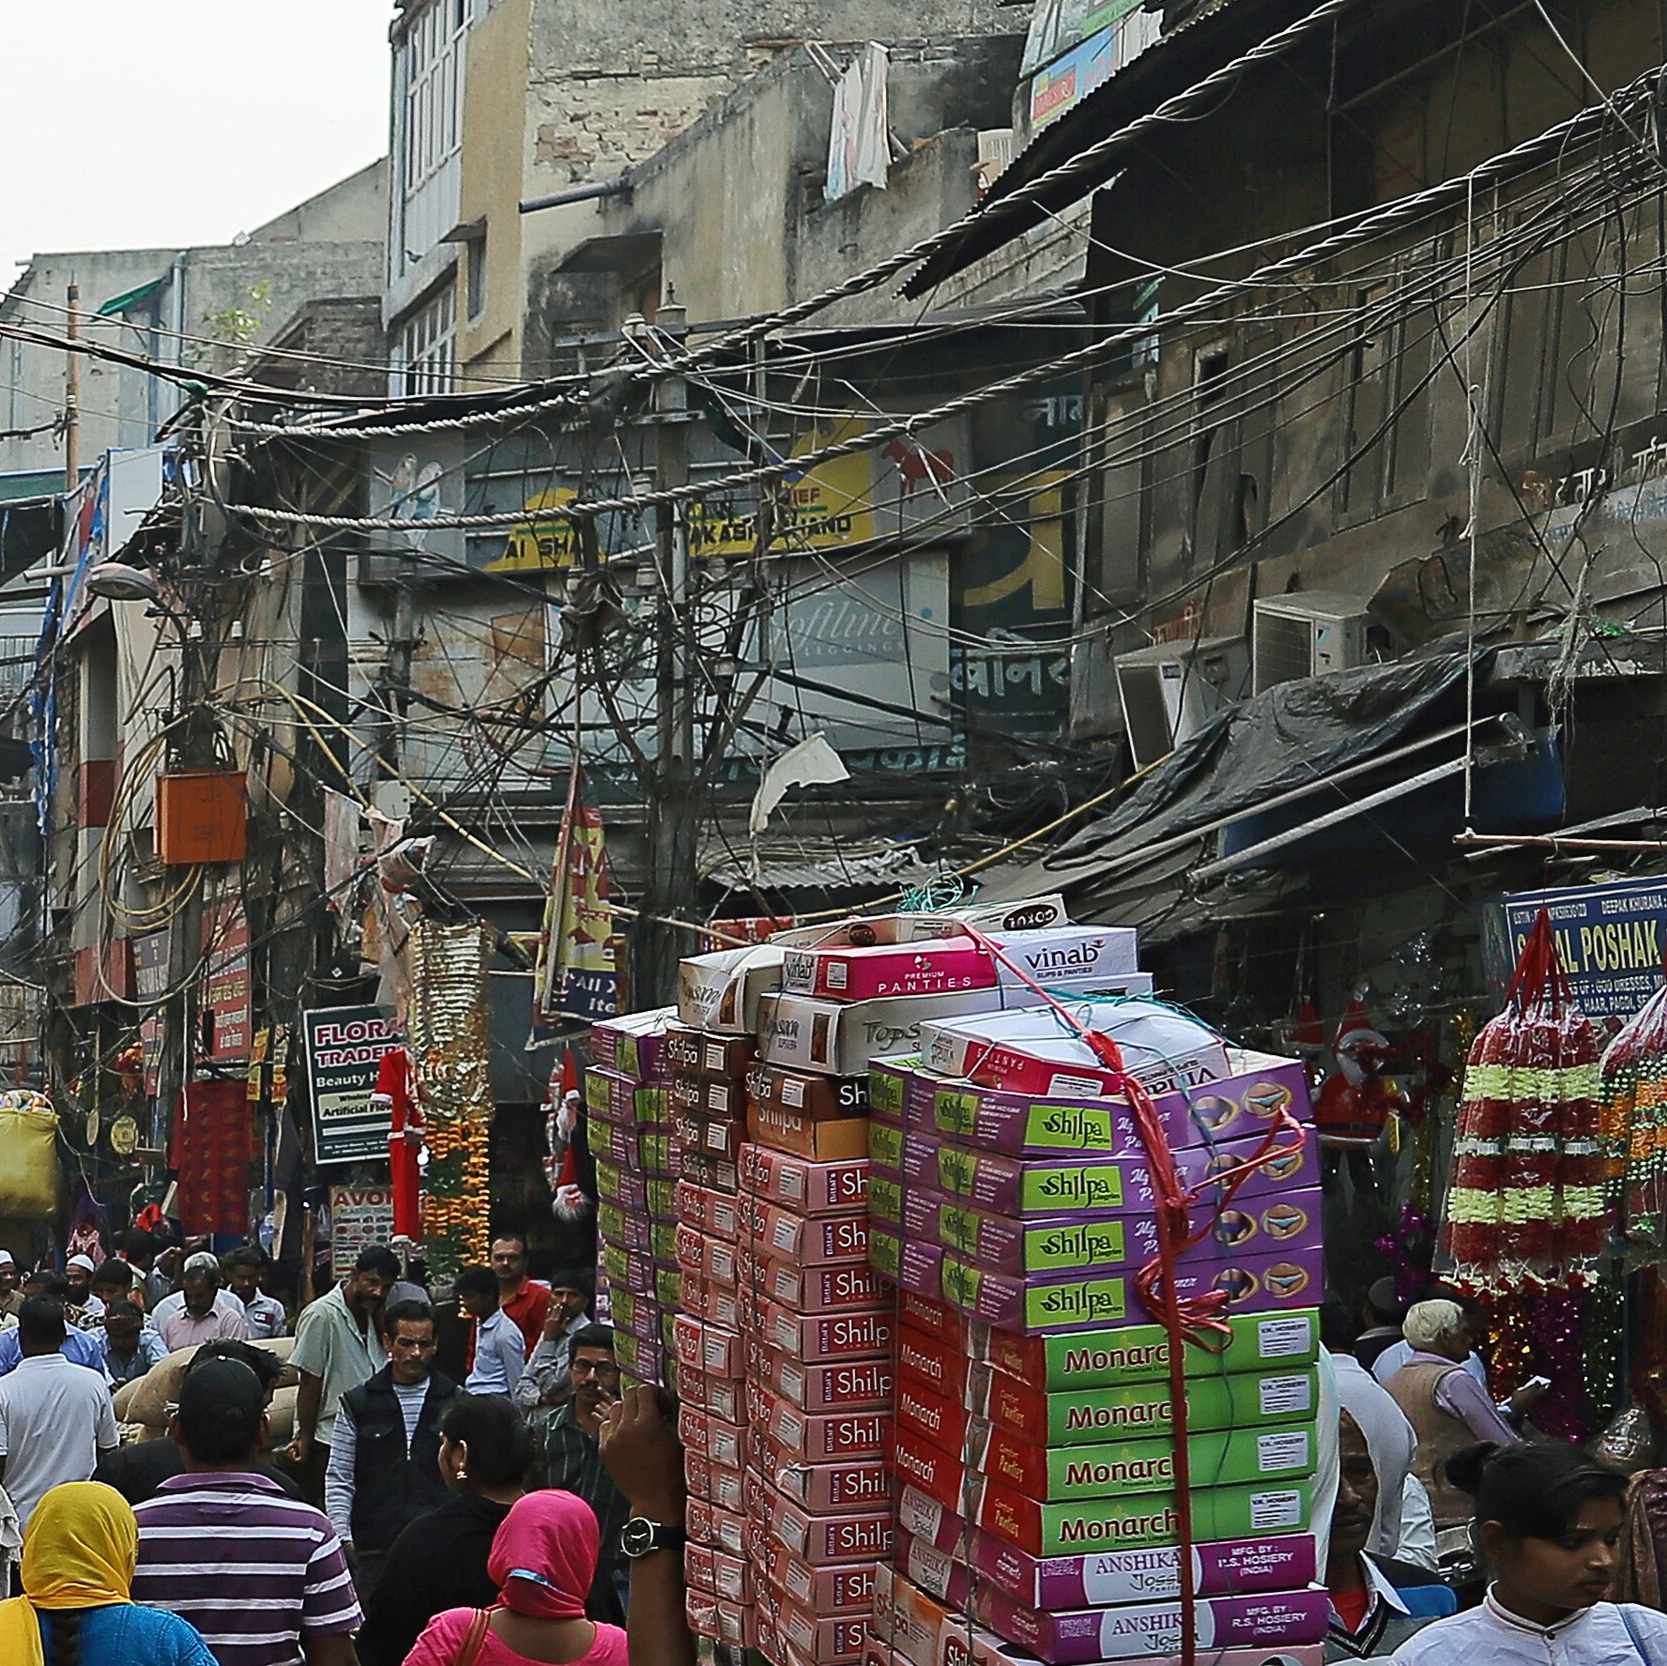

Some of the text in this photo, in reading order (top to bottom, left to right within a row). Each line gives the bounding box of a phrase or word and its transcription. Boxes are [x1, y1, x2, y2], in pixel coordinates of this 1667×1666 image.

[1025, 942, 1101, 970] vinab
[1581, 919, 1662, 972] POSHAK
[878, 976, 972, 993] PANTIES
[904, 971, 945, 981] PREMIUM
[316, 1072, 365, 1088] Beauty
[322, 1103, 369, 1117] Artificial
[1043, 1109, 1103, 1149] Shilpa
[1039, 1167, 1111, 1208] Shilpa
[1040, 1225, 1112, 1265] Shilpa
[1040, 1282, 1112, 1322] Shilpa
[834, 1317, 890, 1347] Shilp
[837, 1367, 892, 1397] Shilp
[839, 1418, 881, 1445] Shil
[845, 1469, 886, 1496] Shil
[841, 1521, 894, 1550] Shilp
[1059, 1508, 1180, 1544] Monarch
[1240, 1564, 1273, 1576] (INDIA)
[1243, 1552, 1293, 1566] HOSIERY
[1059, 1618, 1092, 1630] PREMIUM
[1113, 1612, 1189, 1636] ANSHIK
[1232, 1612, 1307, 1628] R.S. HOSIERY
[1253, 1624, 1287, 1636] (INDIA)
